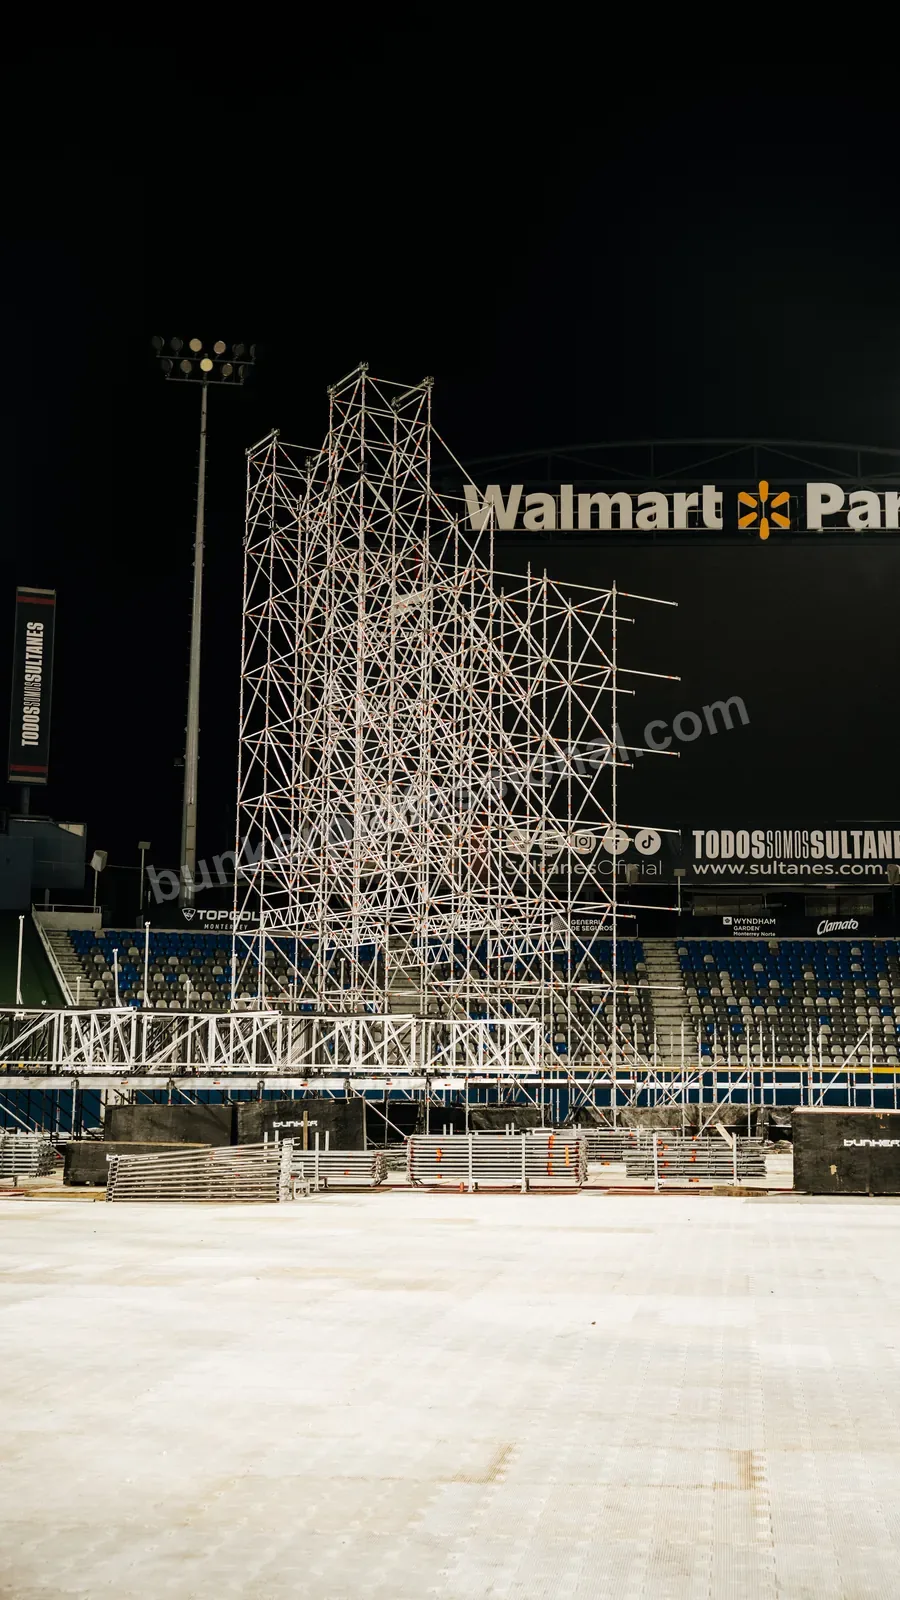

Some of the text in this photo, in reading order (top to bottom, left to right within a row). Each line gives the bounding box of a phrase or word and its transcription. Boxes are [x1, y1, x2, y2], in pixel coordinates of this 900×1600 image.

[463, 484, 723, 530] Walmart
[505, 859, 662, 875] SultanesOfiial
[692, 861, 900, 875] www.sultanes.com.
[197, 909, 269, 922] TOPGOL
[816, 918, 859, 936] Clamato
